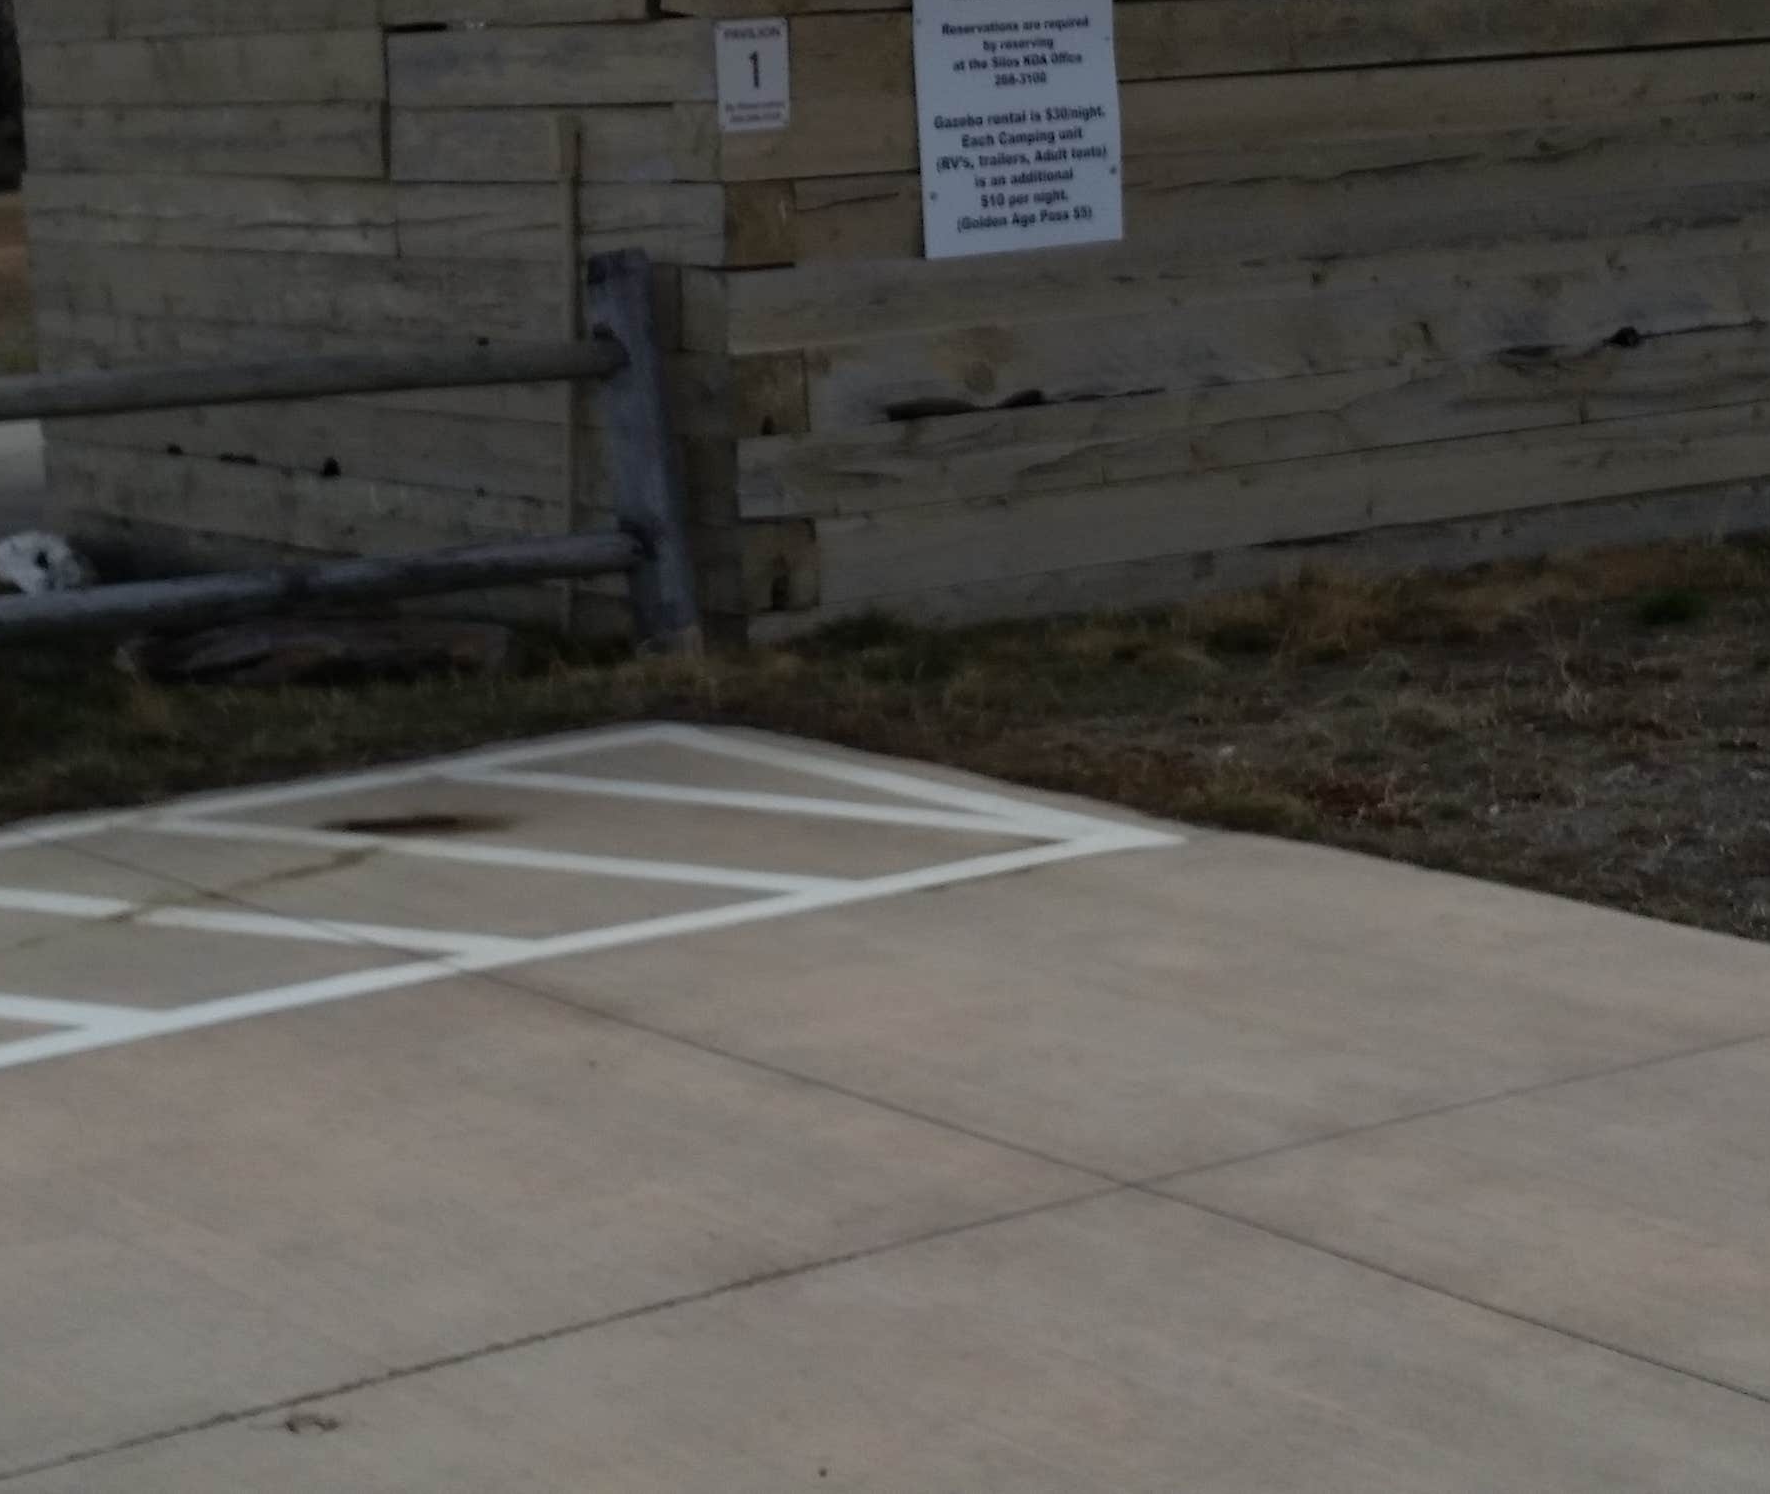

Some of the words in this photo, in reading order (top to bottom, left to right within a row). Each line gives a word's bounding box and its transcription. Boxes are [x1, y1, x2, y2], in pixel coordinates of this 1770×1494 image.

[942, 21, 1018, 35] Reservations
[1023, 21, 1041, 30] are
[1044, 16, 1088, 31] required
[983, 40, 996, 52] by
[749, 51, 759, 88] 1
[969, 58, 987, 69] the
[934, 115, 982, 128] Gazebo
[1030, 110, 1041, 121] is
[962, 135, 994, 148] Each
[999, 131, 1055, 145] Camping
[975, 177, 985, 187] is
[991, 176, 1005, 186] an
[1011, 168, 1073, 184] additional
